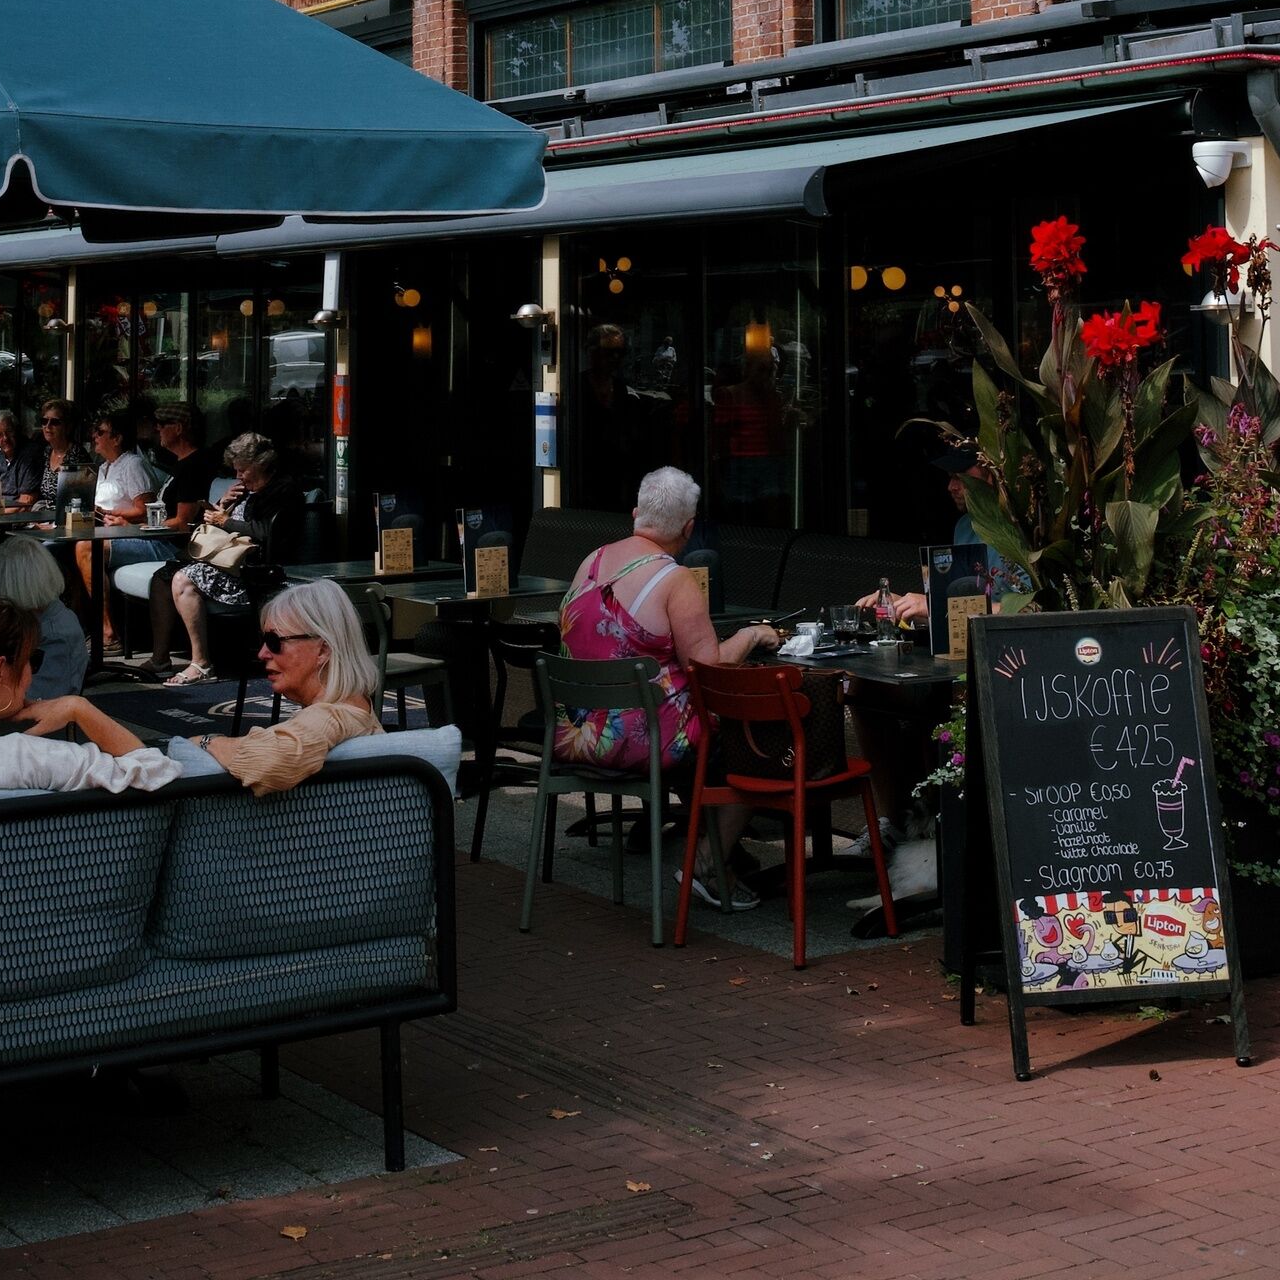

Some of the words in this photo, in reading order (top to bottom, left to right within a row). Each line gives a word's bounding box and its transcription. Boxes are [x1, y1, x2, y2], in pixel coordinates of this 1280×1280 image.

[1090, 782, 1131, 803] €0,50
[1090, 842, 1140, 858] chocolade
[1038, 862, 1123, 892] Slagroom
[1134, 860, 1174, 880] €0,75
[1147, 915, 1184, 934] Lipton
